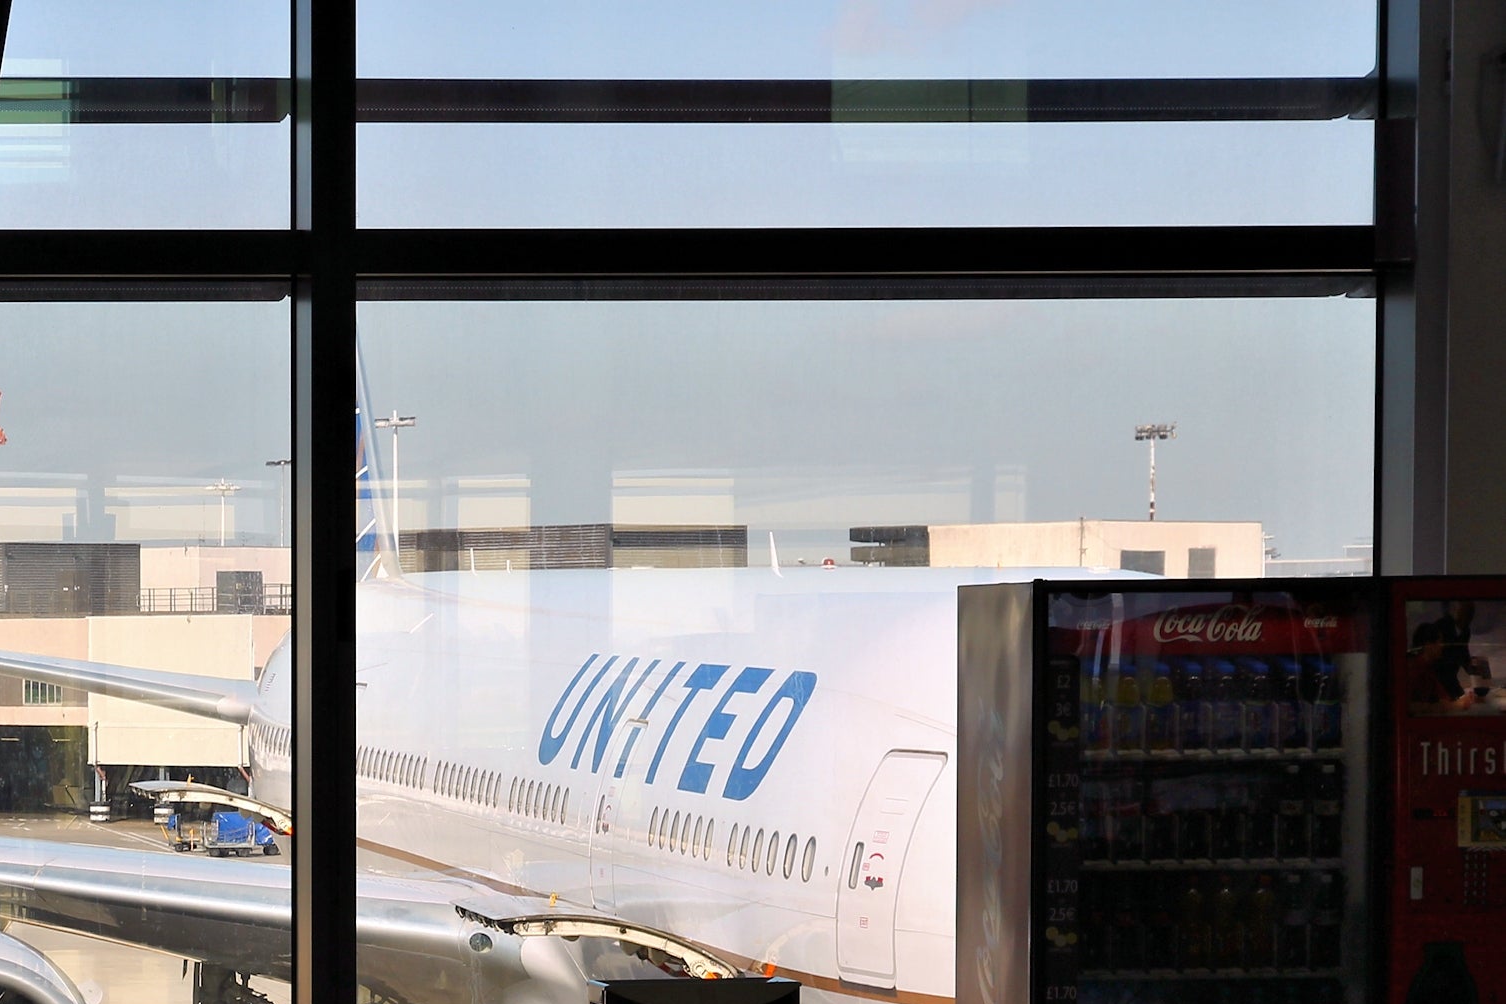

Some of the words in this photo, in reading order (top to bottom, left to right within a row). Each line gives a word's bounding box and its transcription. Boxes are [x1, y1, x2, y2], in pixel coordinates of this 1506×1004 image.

[1153, 604, 1264, 643] Coca-Cola
[1055, 673, 1071, 689] £2
[538, 653, 818, 802] UNITED
[1048, 773, 1079, 788] £1.70
[1047, 879, 1079, 894] £1.70
[1046, 985, 1077, 1000] £1.70
